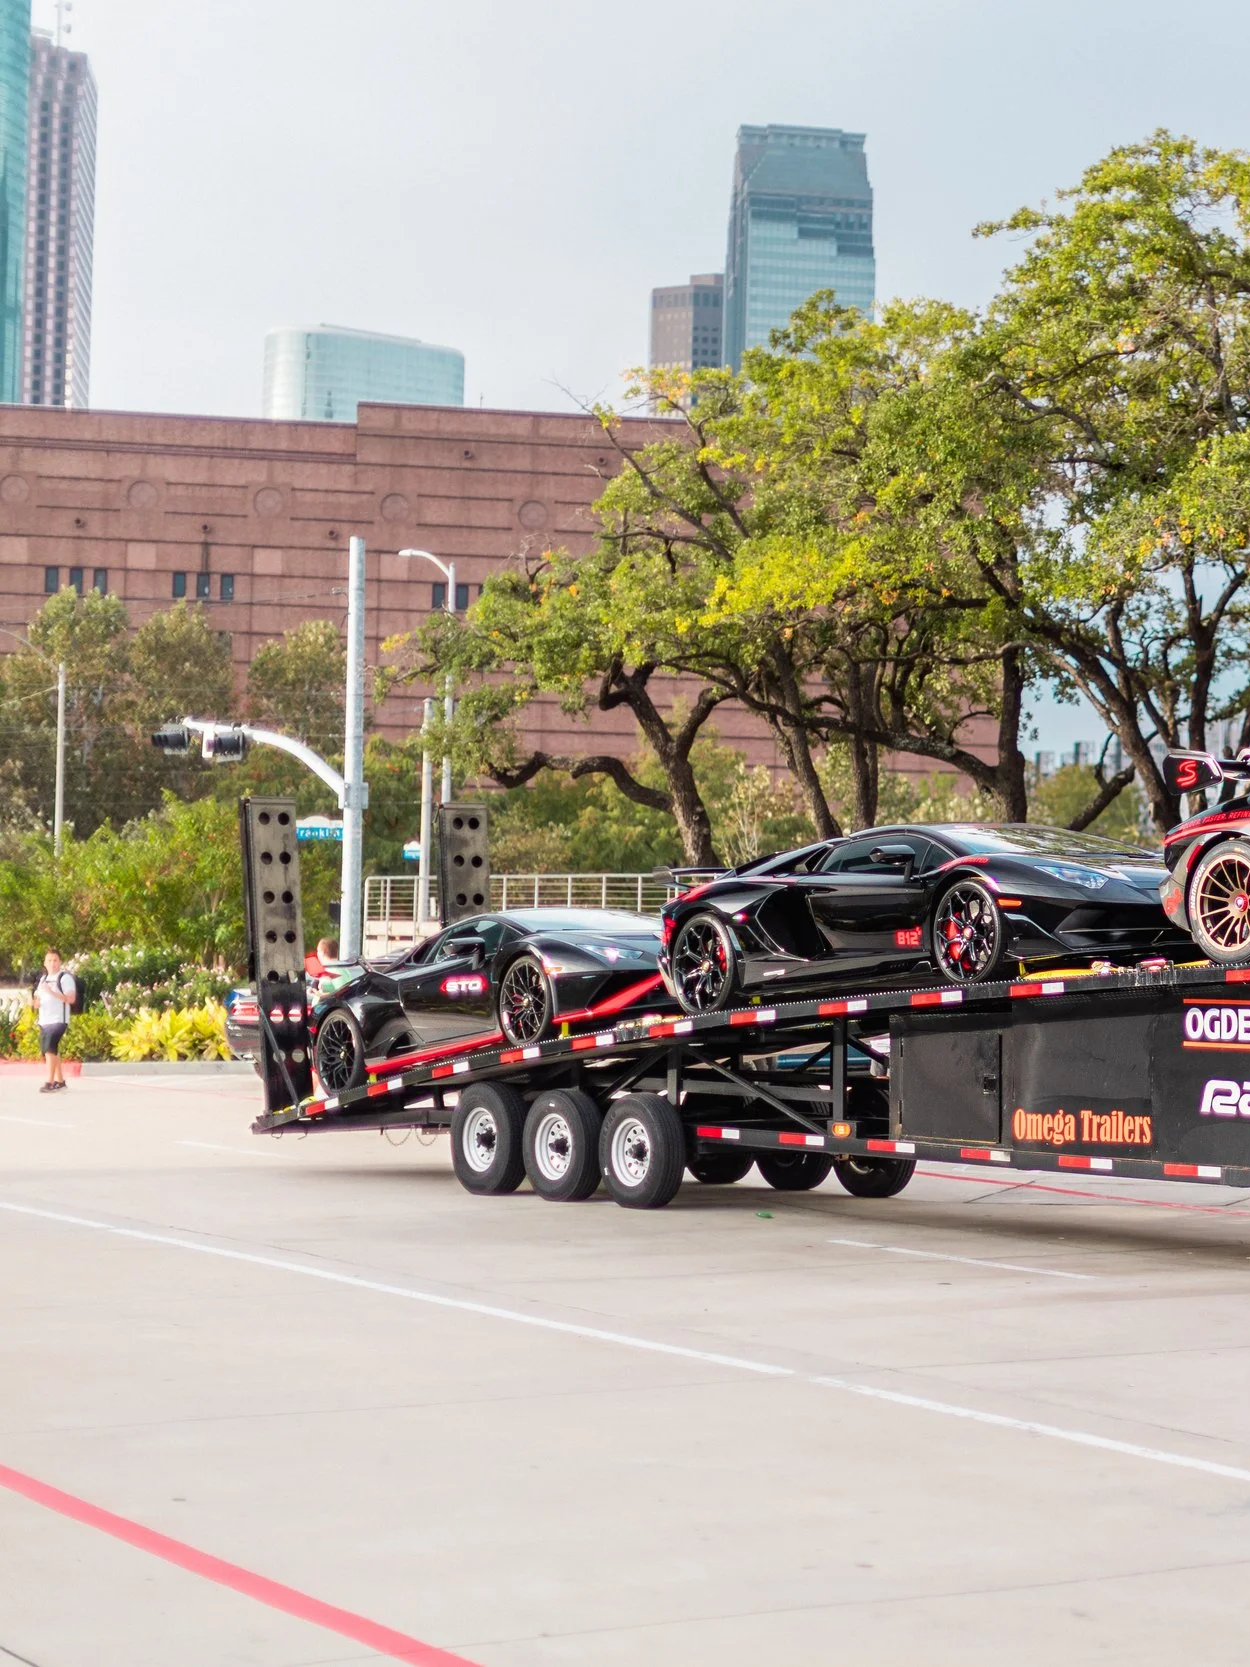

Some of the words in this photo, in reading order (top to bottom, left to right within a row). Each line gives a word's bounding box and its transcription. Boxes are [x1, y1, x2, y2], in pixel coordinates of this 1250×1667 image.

[897, 930, 919, 945] 812
[445, 978, 483, 993] STO
[1013, 1108, 1075, 1145] Omega
[1081, 1110, 1151, 1144] Trailers
